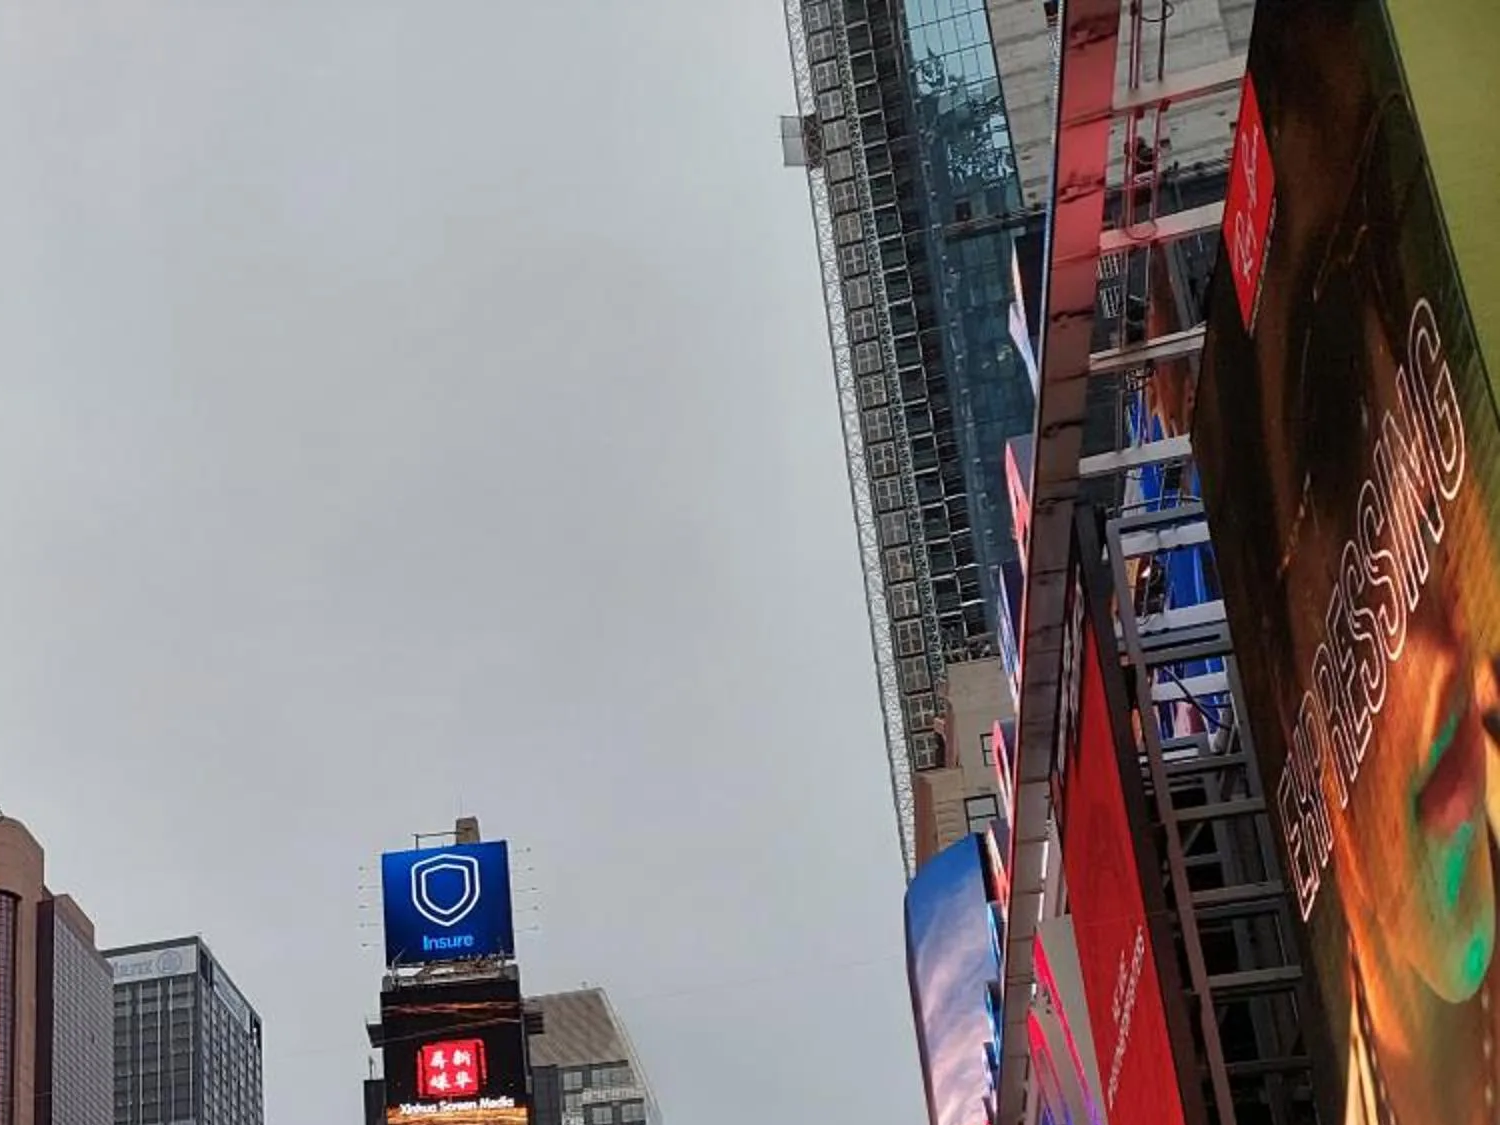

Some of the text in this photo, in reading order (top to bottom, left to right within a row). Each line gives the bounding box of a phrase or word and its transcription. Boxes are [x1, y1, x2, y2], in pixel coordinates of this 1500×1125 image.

[423, 934, 475, 951] Insure
[400, 1095, 515, 1115] Xinhua Screen Media
